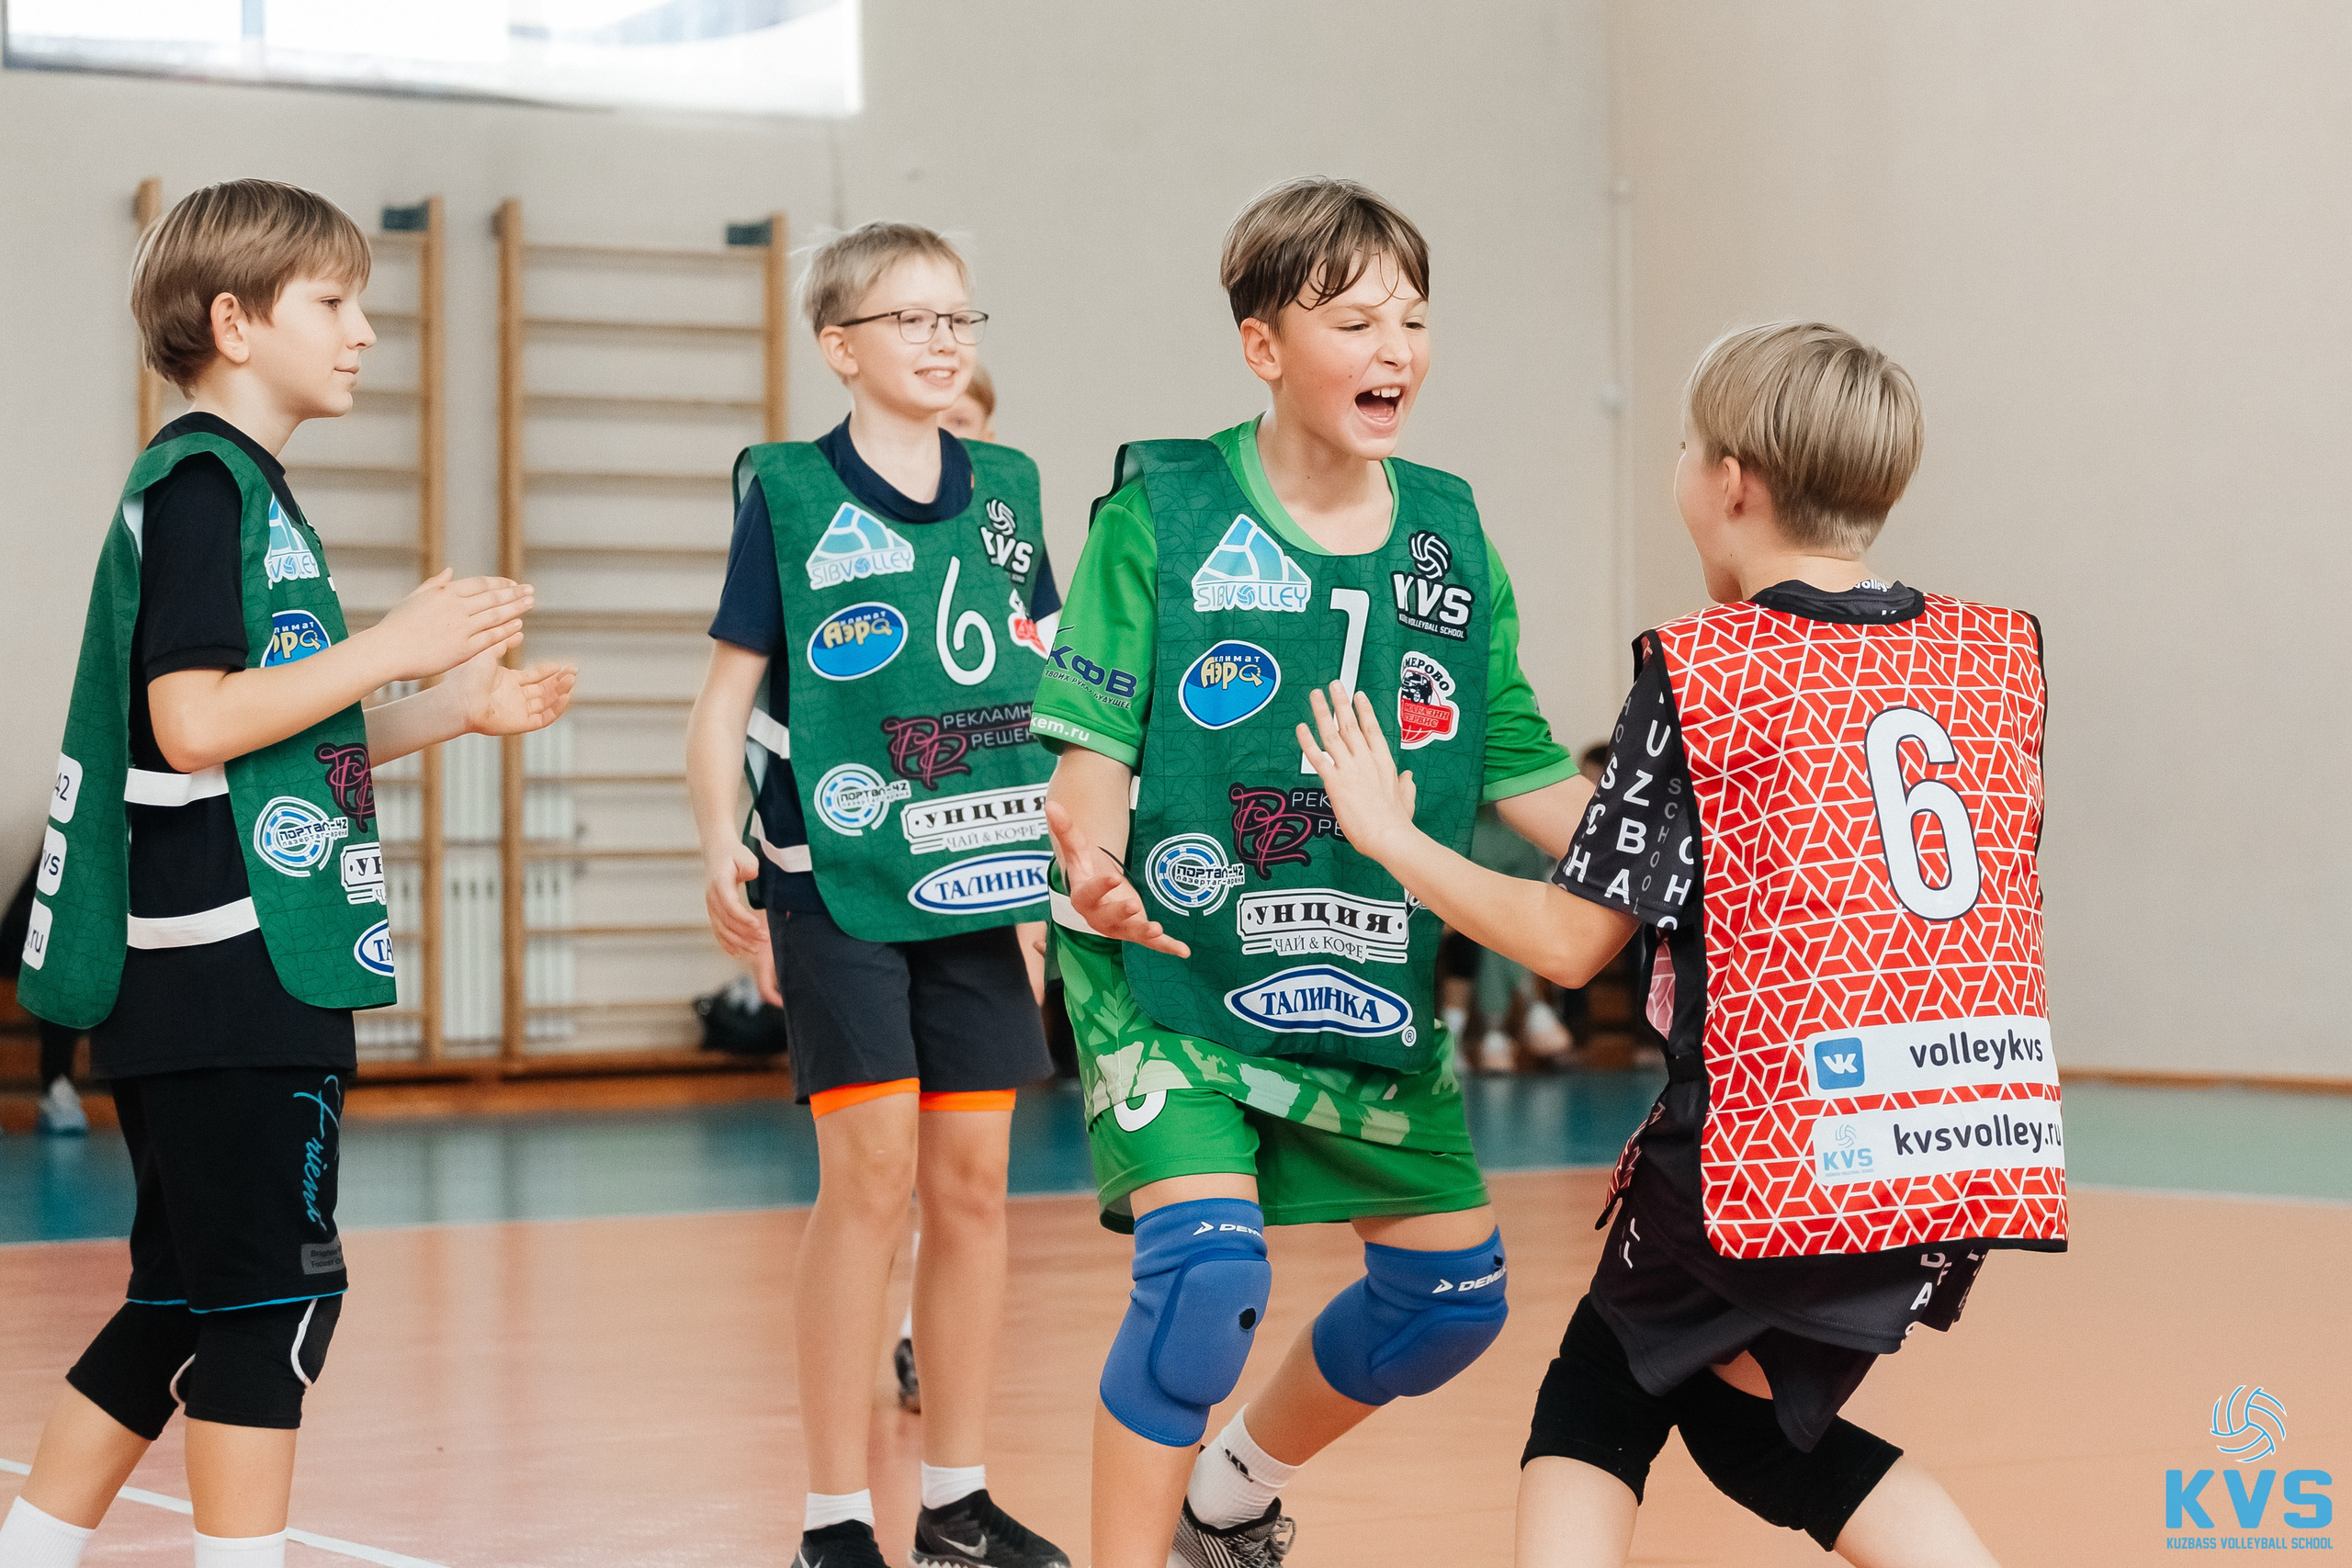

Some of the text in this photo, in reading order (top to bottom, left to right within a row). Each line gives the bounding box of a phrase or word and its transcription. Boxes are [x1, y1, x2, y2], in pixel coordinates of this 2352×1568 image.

[1393, 573, 1473, 626] KVS
[936, 556, 996, 686] 6
[943, 705, 1031, 729] РЕКЛАМН
[1864, 706, 1982, 922] 6
[946, 833, 978, 849] ЧАЙ
[995, 825, 1037, 841] КОФЕ
[935, 866, 1047, 901] ТАЛИНК
[1253, 902, 1394, 934] УНЦИЯ
[1274, 935, 1363, 959] ЧАЙ & КОФЕ
[1260, 986, 1382, 1024] ТАЛИНКА
[1909, 1029, 2044, 1070] volleykvs
[1893, 1113, 2062, 1156] kvsvolley.ru
[1823, 1147, 1873, 1171] KVS
